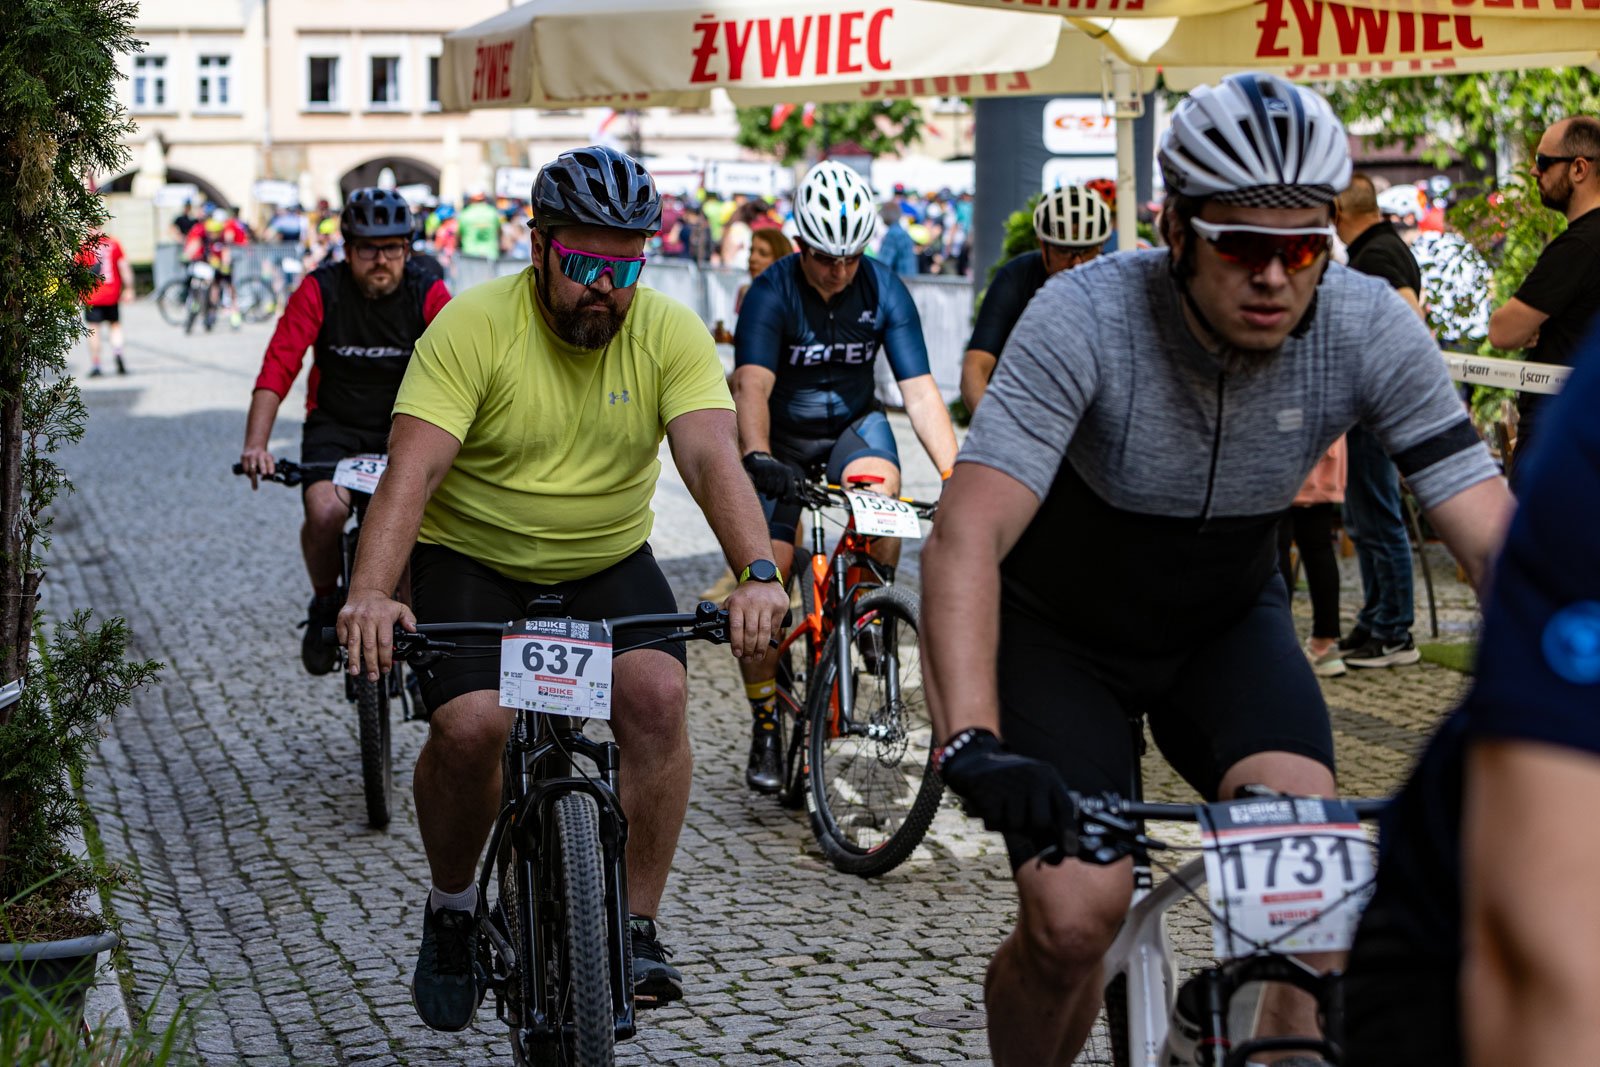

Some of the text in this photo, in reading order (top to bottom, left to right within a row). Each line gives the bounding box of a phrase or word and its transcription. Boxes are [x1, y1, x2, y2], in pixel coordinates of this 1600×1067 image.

[690, 8, 893, 84] ŻYWIEC
[472, 40, 513, 101] ŻYWIE
[1468, 366, 1490, 376] SCOTT
[1525, 373, 1550, 385] SCOTT
[538, 620, 567, 630] BIKE
[522, 642, 593, 677] 637
[549, 687, 573, 696] BIKE
[1222, 838, 1353, 889] 1731
